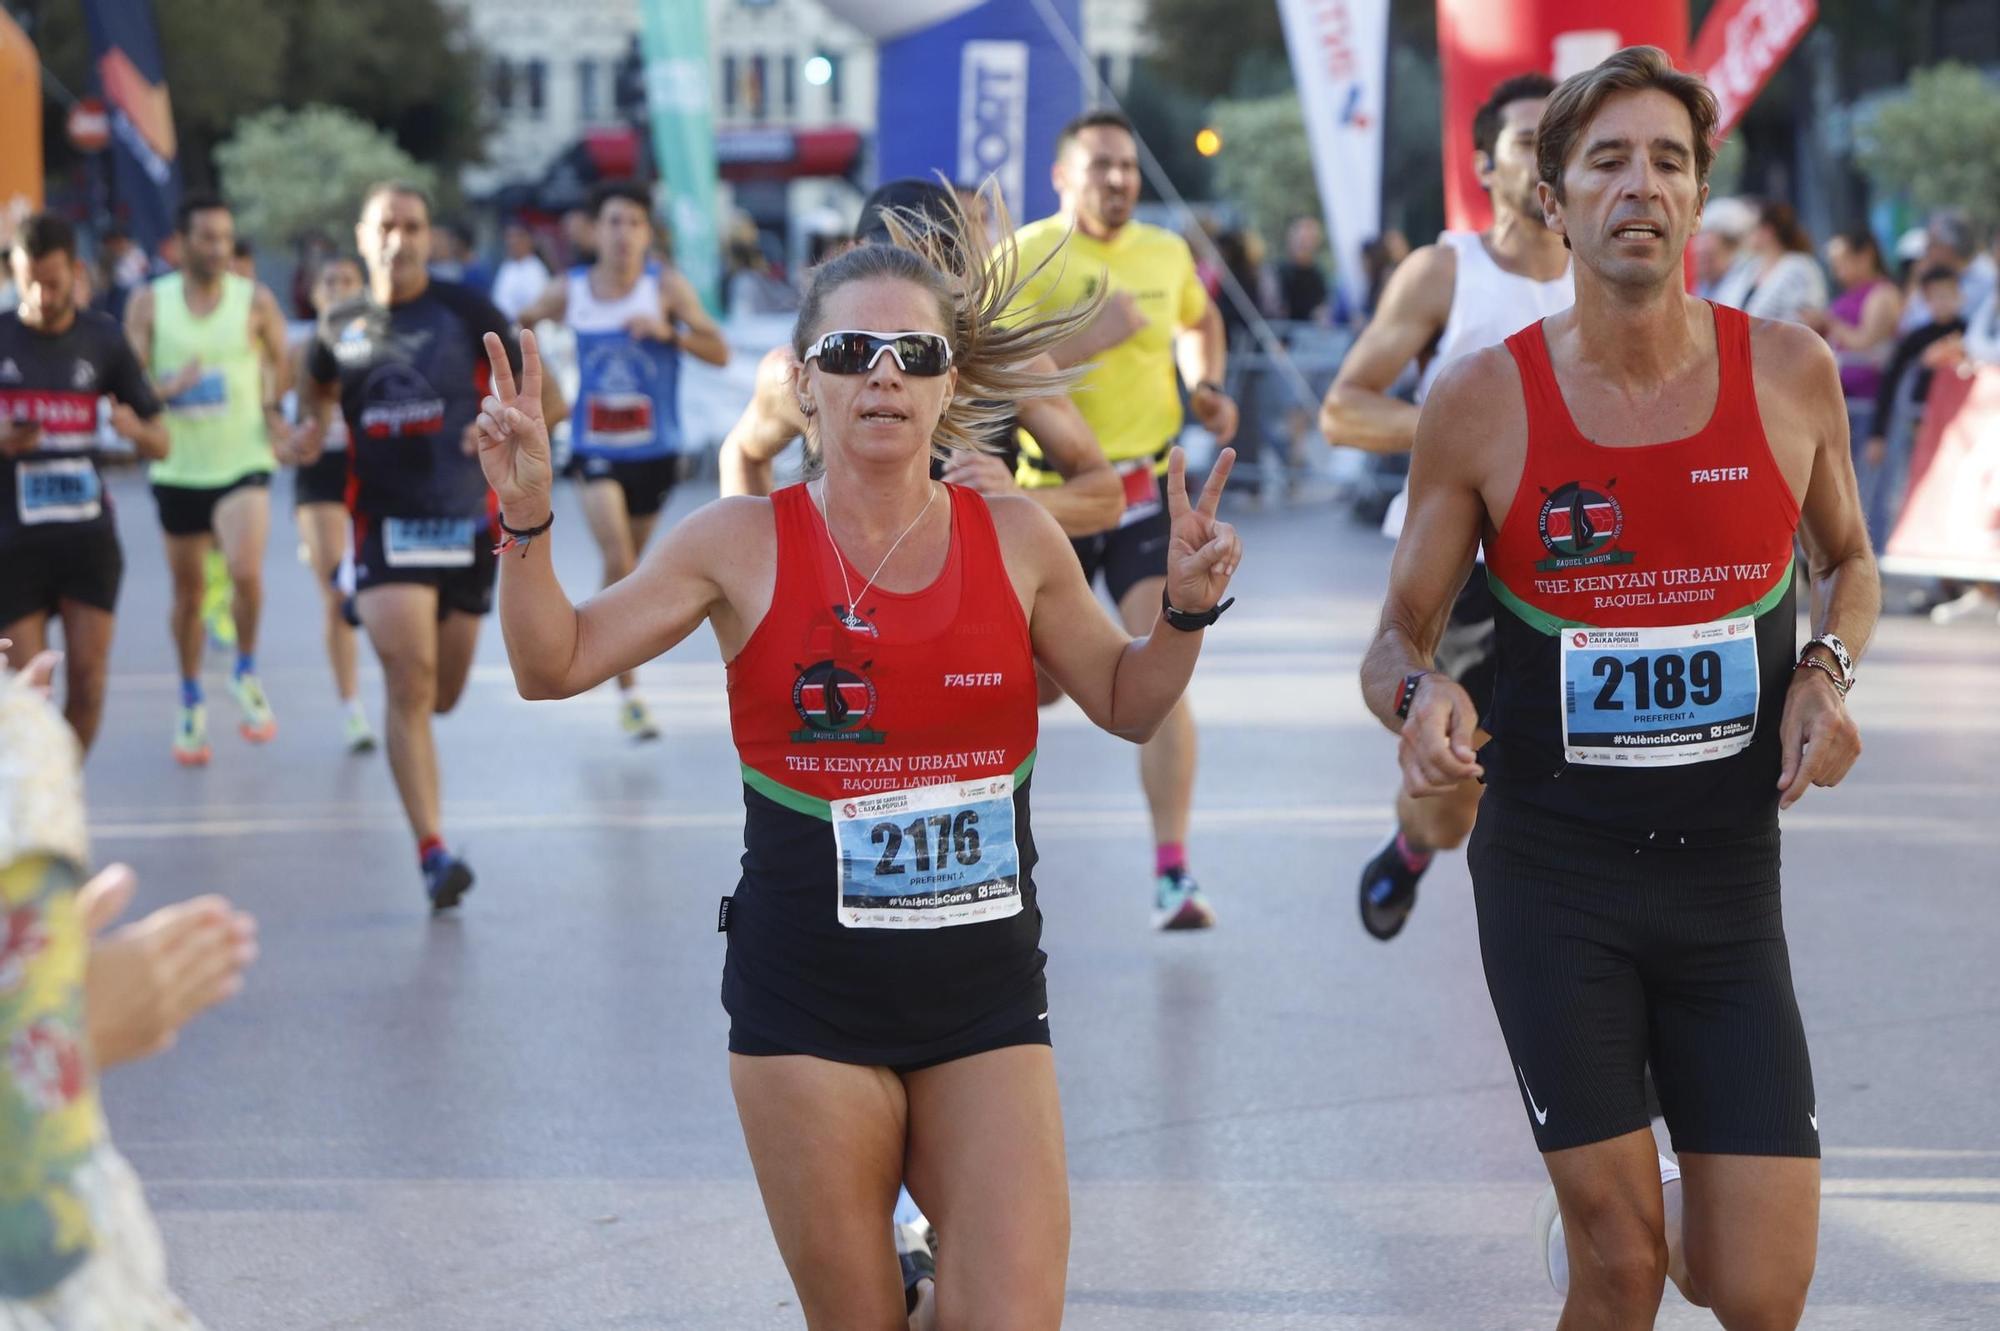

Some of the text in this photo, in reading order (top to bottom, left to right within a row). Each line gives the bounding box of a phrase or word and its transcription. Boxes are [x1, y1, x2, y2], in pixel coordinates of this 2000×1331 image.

[1691, 467, 1748, 483] FASTER
[1556, 554, 1611, 567] RAQUEL LANDIN
[1535, 563, 1771, 594] THE KENYAN URBAN WAY
[1594, 588, 1715, 608] RAQUEL LANDIN
[944, 673, 1002, 687] FASTER
[1593, 650, 1722, 710] 2189
[1634, 713, 1687, 723] PREFERENT
[1613, 732, 1703, 745] #ValènciaCorre
[786, 750, 1006, 772] THE KENYAN URBAN WAY
[842, 774, 957, 790] RAQUEL LANDIN
[871, 810, 982, 875] 2176
[910, 875, 955, 886] PREFERENT
[889, 892, 972, 906] #ValènciaCorre
[720, 901, 729, 927] FASTER
